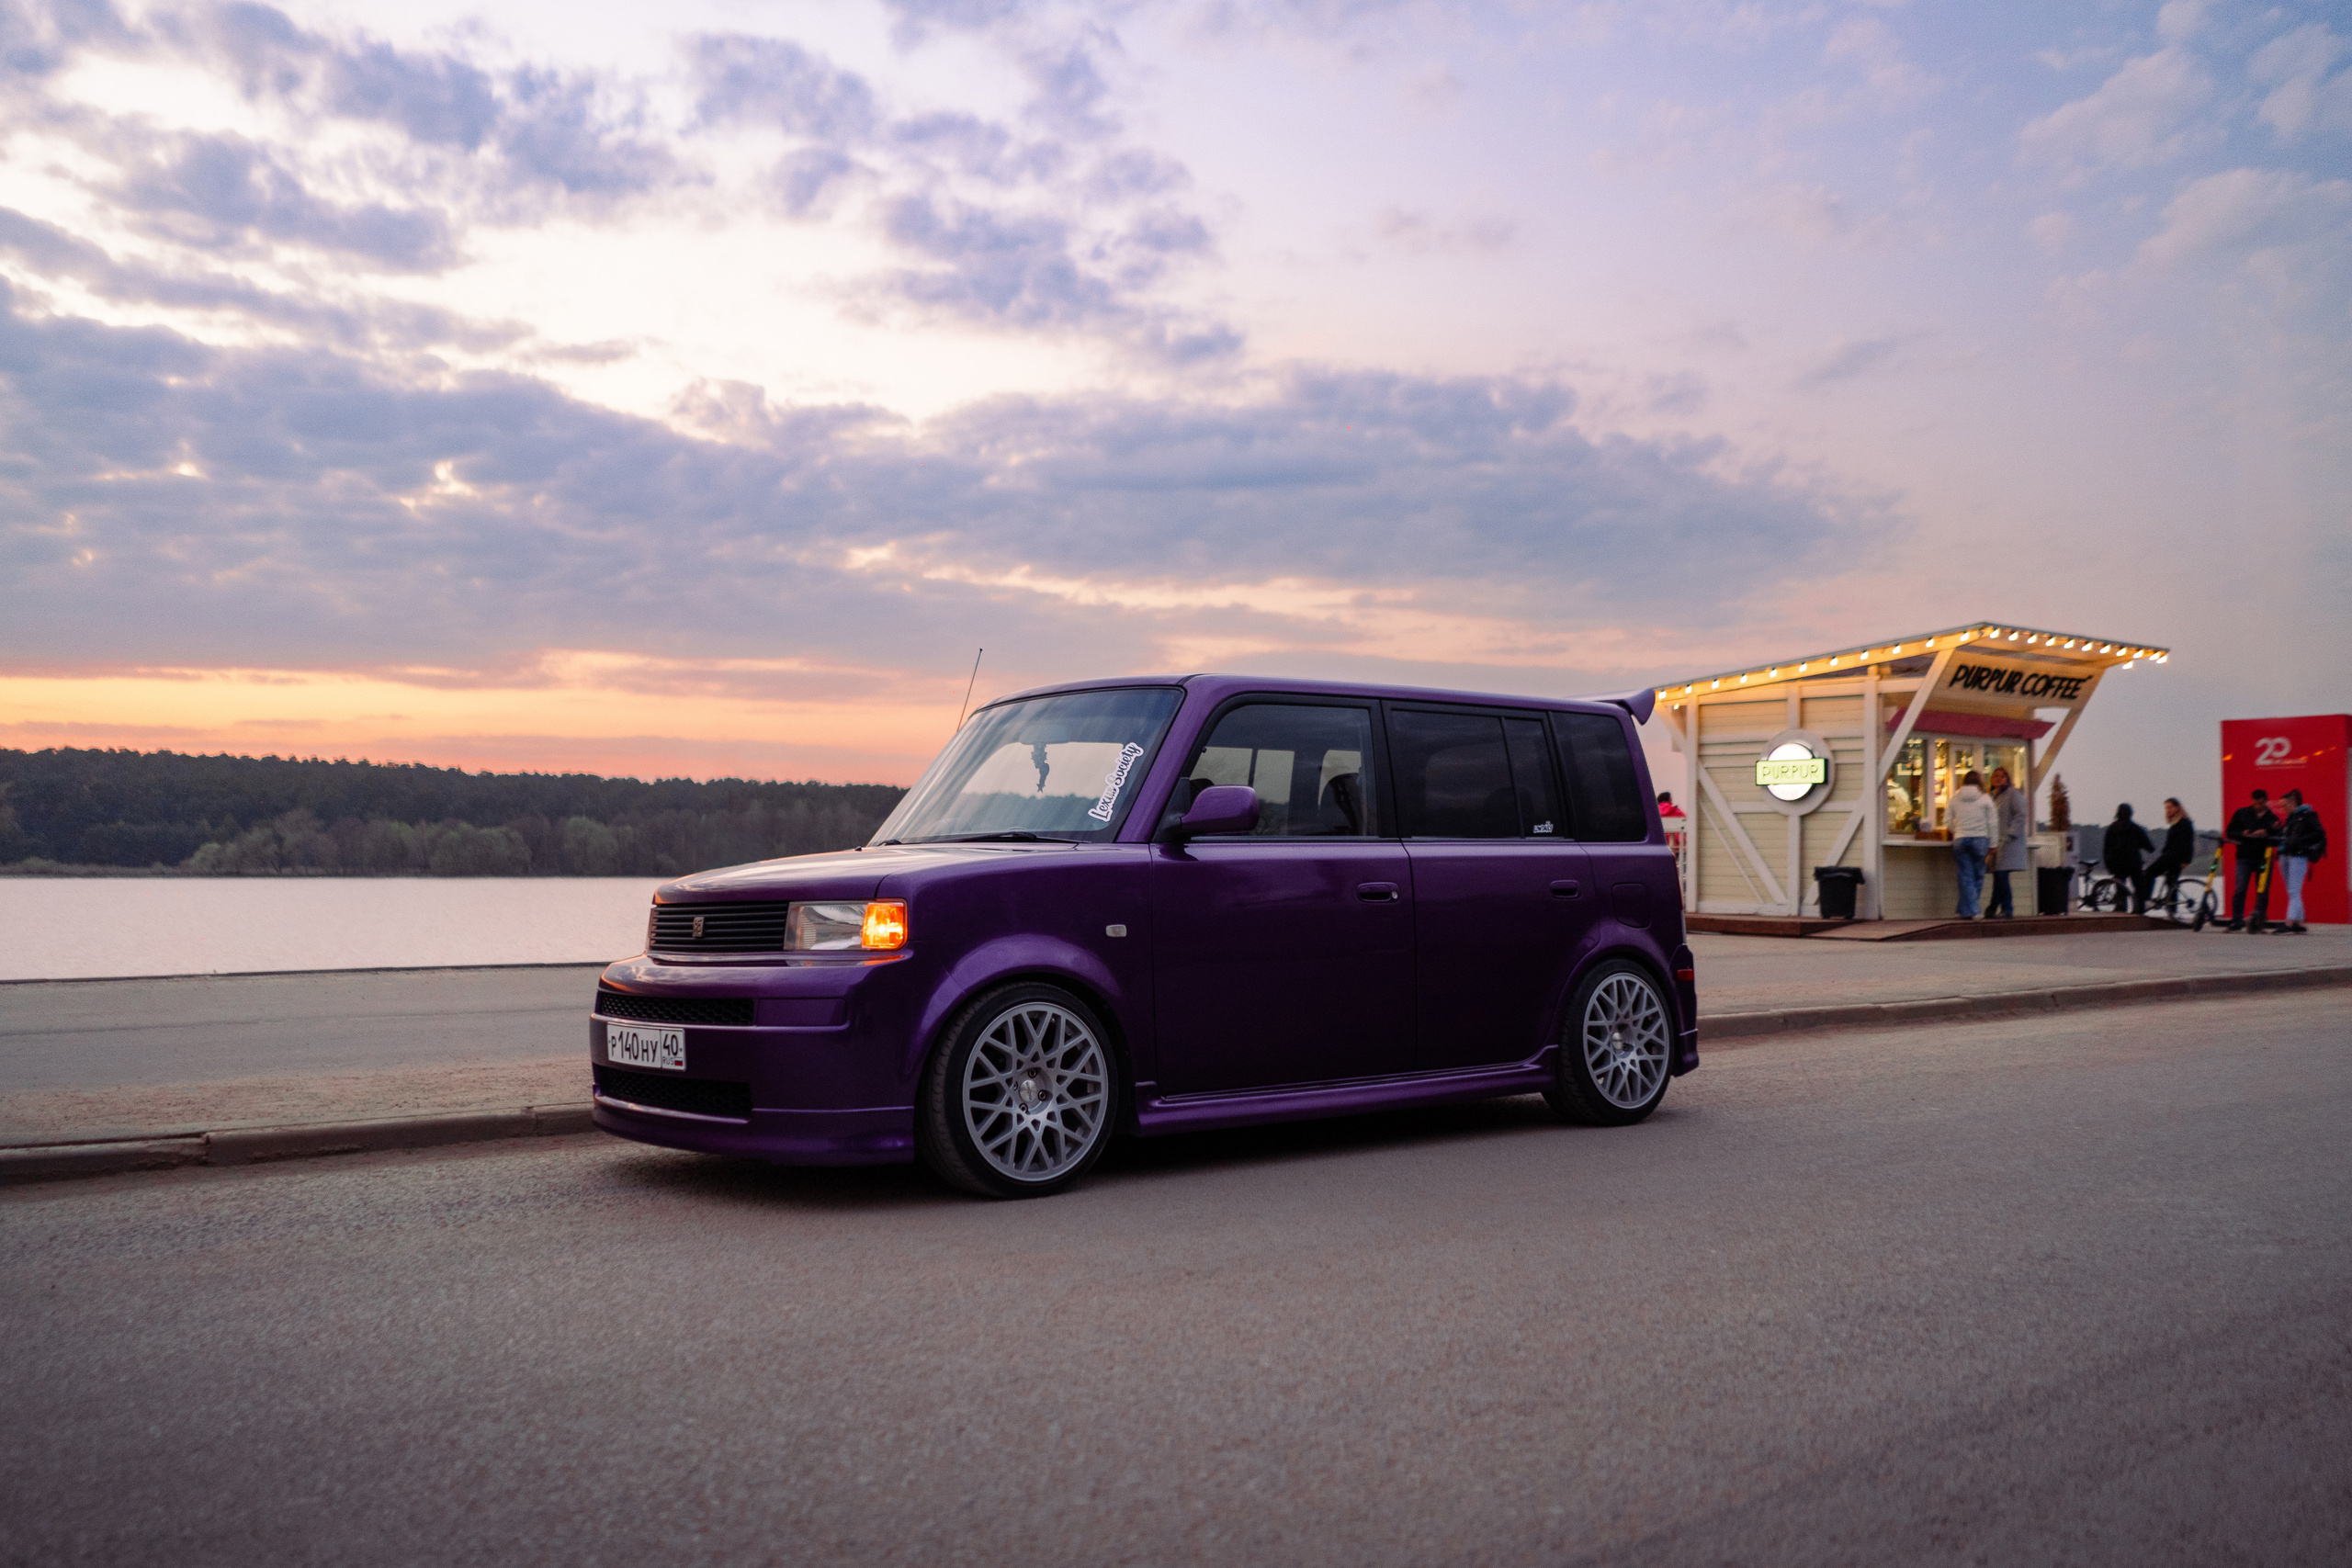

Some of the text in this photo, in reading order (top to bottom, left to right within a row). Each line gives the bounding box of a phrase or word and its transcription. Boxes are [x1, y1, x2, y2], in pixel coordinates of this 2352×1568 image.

[1949, 664, 2094, 700] PURPUR COFFEE
[1106, 743, 1142, 786] Society
[1761, 764, 1819, 780] PURPUR
[662, 1033, 679, 1056] 40
[662, 1056, 674, 1066] RUS
